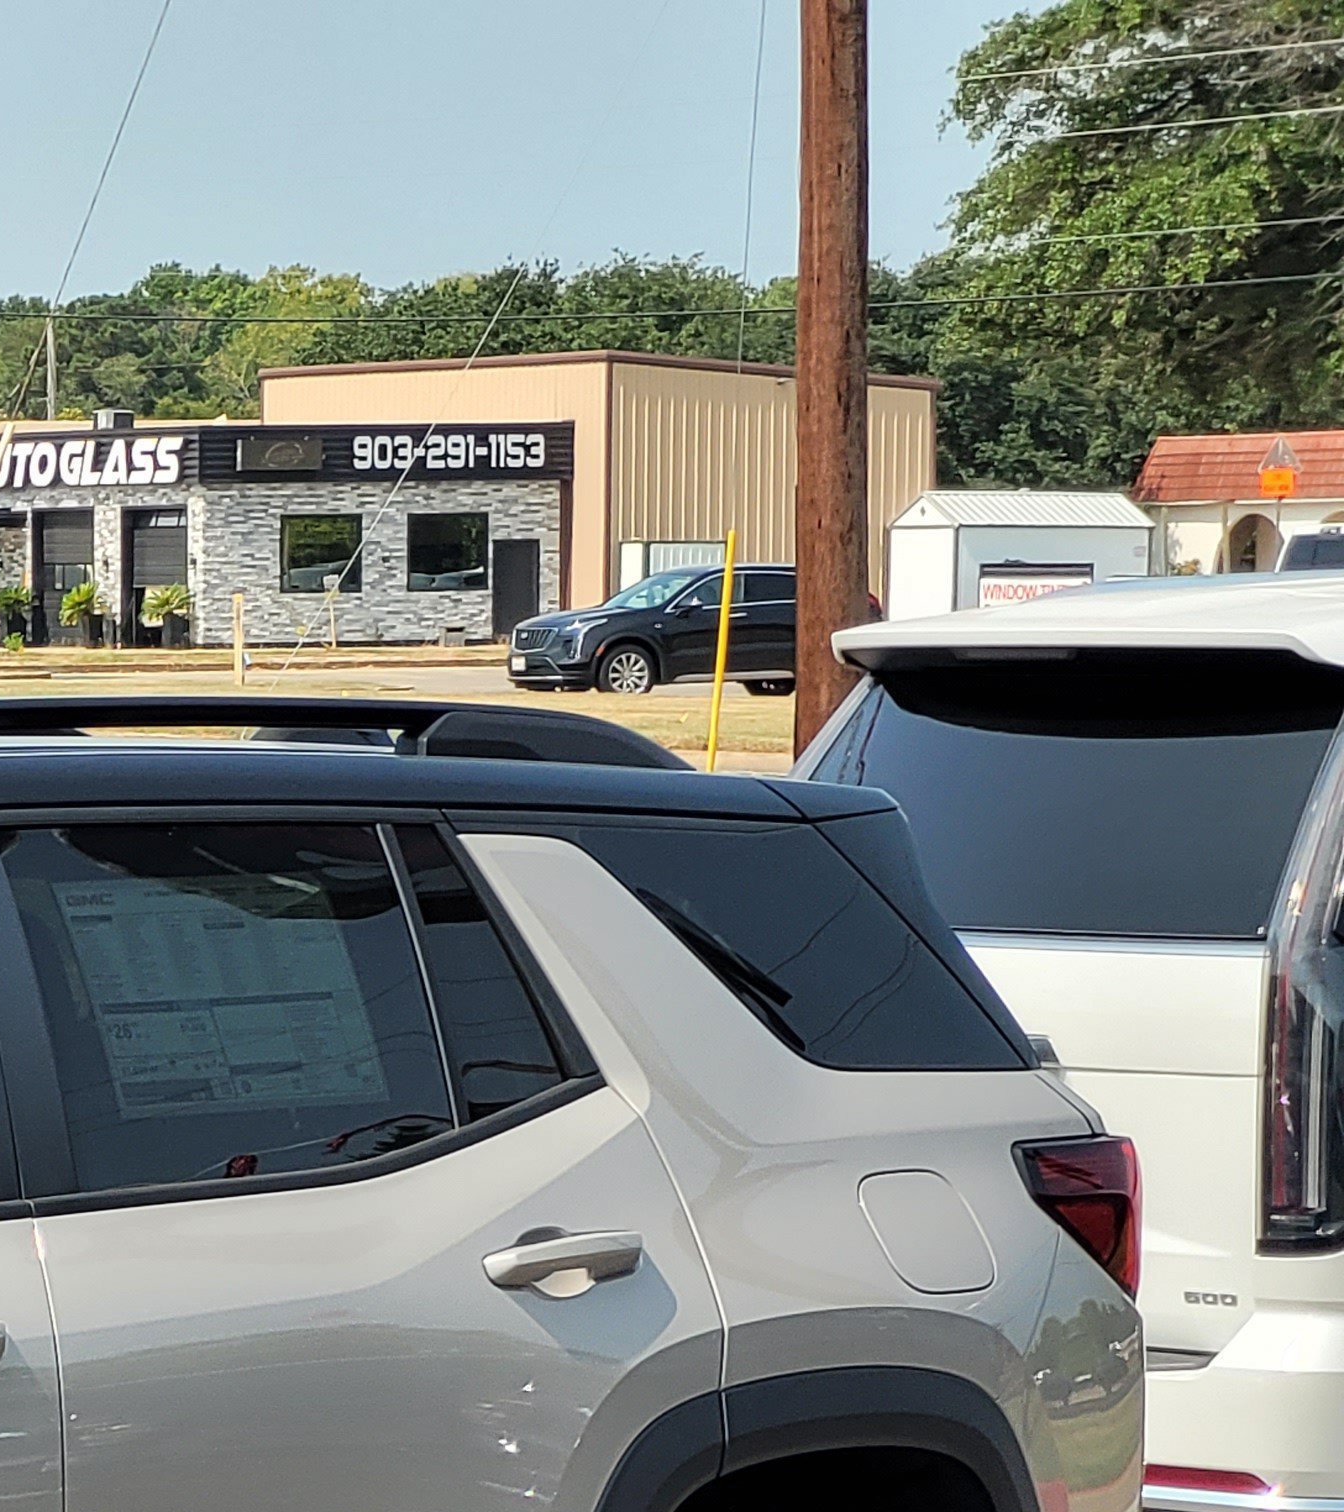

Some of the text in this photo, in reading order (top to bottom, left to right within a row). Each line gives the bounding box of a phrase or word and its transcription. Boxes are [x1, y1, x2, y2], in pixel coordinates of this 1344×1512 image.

[353, 434, 545, 470] 903-291-1153
[983, 584, 1038, 600] WINDOW
[1184, 1291, 1238, 1307] 600
